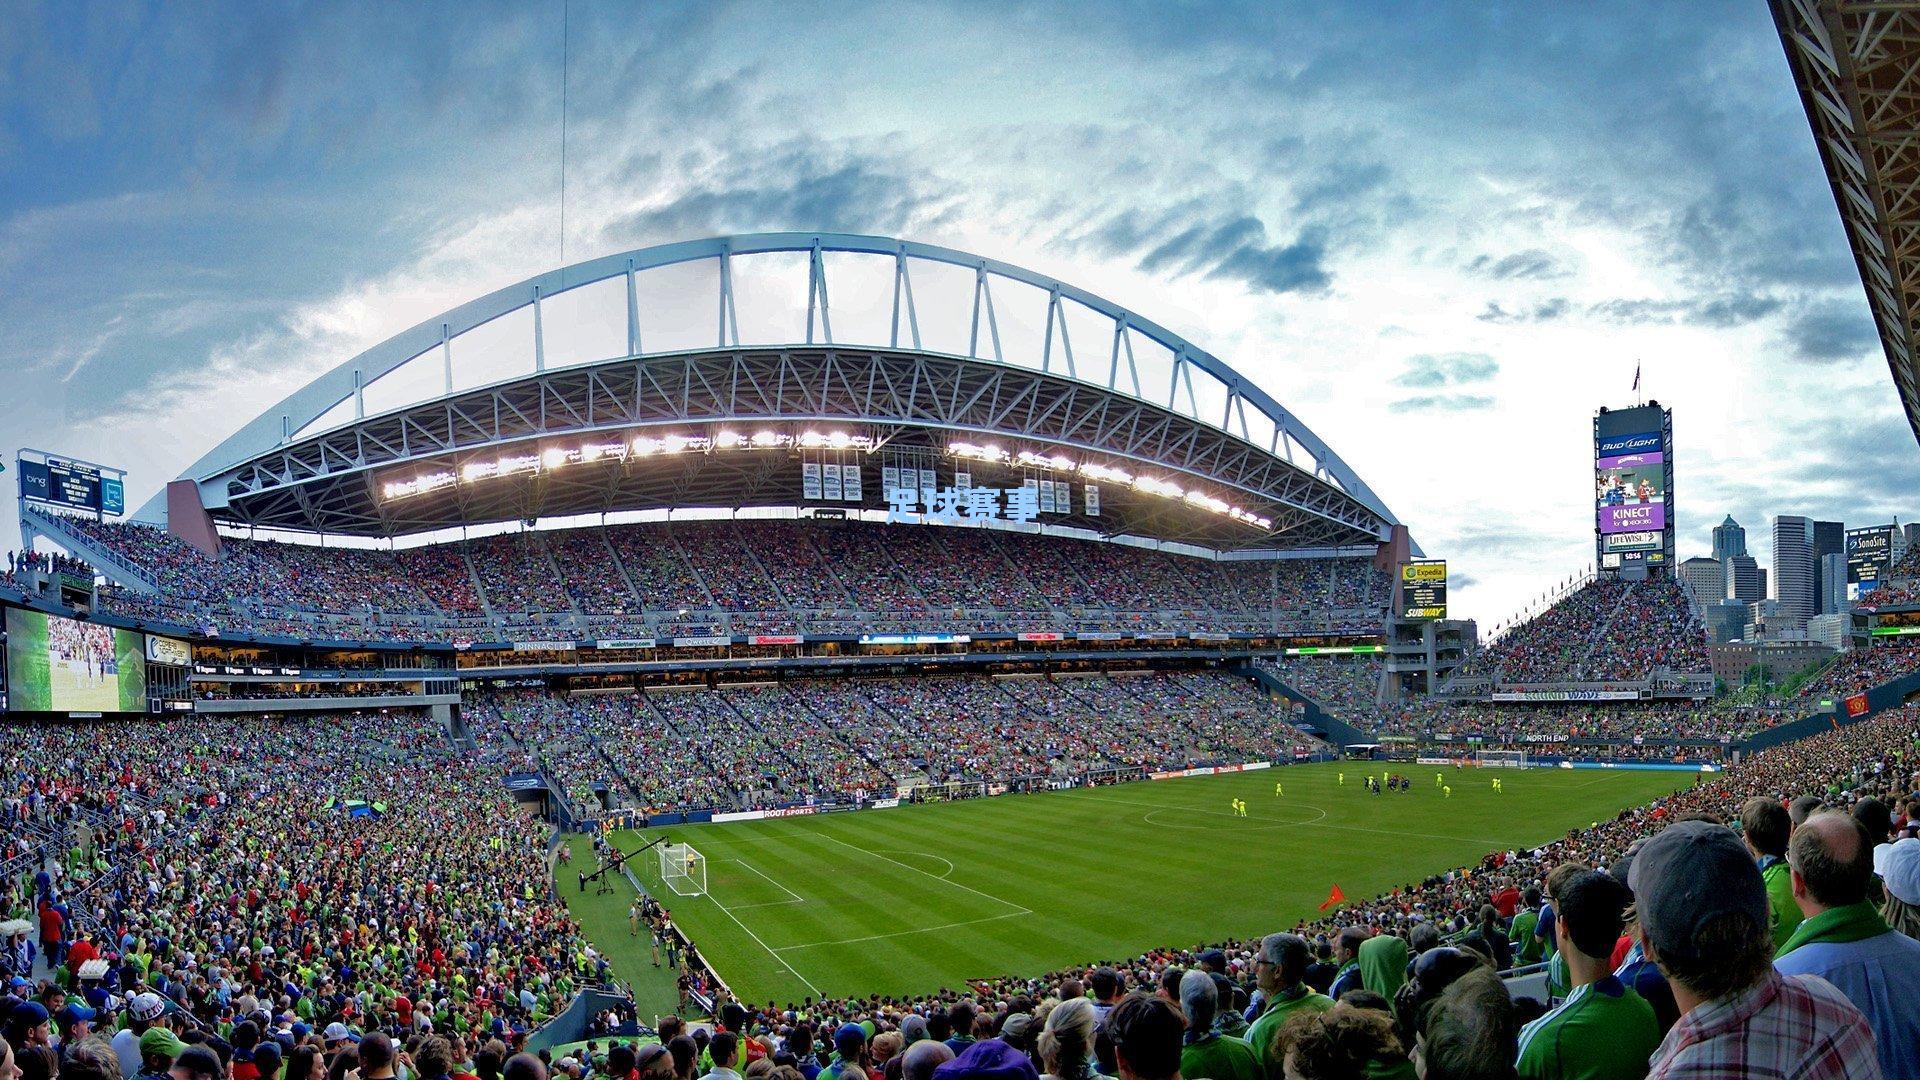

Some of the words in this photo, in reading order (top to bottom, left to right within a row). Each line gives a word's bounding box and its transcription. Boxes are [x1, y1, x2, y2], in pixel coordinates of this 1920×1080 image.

[1602, 442, 1624, 450] BUD
[1628, 438, 1658, 448] LIGHT
[26, 474, 46, 488] bing
[1613, 506, 1652, 520] KINECT
[1858, 536, 1886, 548] SonoSite
[1417, 569, 1442, 577] Expedia
[1405, 608, 1445, 618] SUBWAY
[518, 642, 564, 650] PINNACLE
[686, 638, 710, 646] Qwest
[764, 810, 786, 818] ROOT
[787, 808, 814, 816] SPORTS
